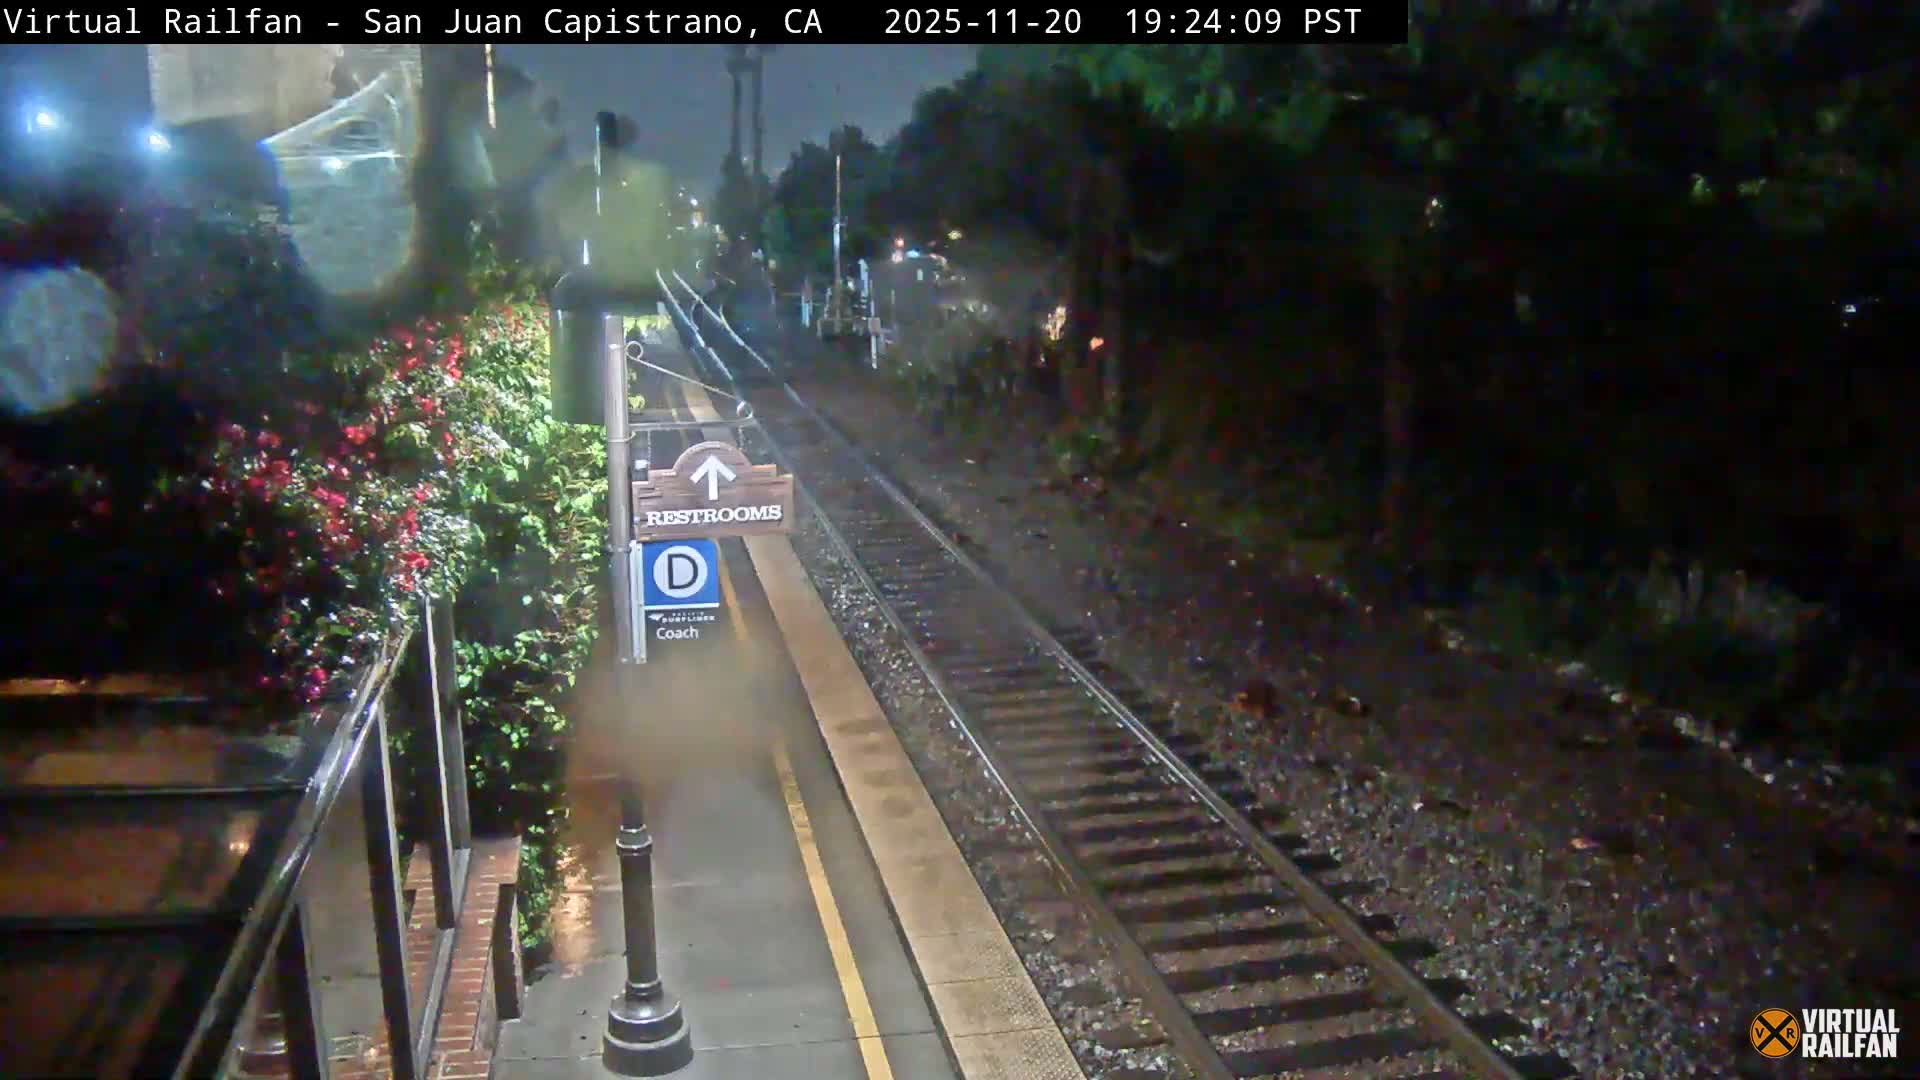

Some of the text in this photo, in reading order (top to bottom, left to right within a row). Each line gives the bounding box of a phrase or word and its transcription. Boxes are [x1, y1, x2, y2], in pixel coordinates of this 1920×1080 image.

[646, 505, 782, 526] RESTROOMS
[667, 553, 699, 590] D
[656, 625, 699, 640] Coach
